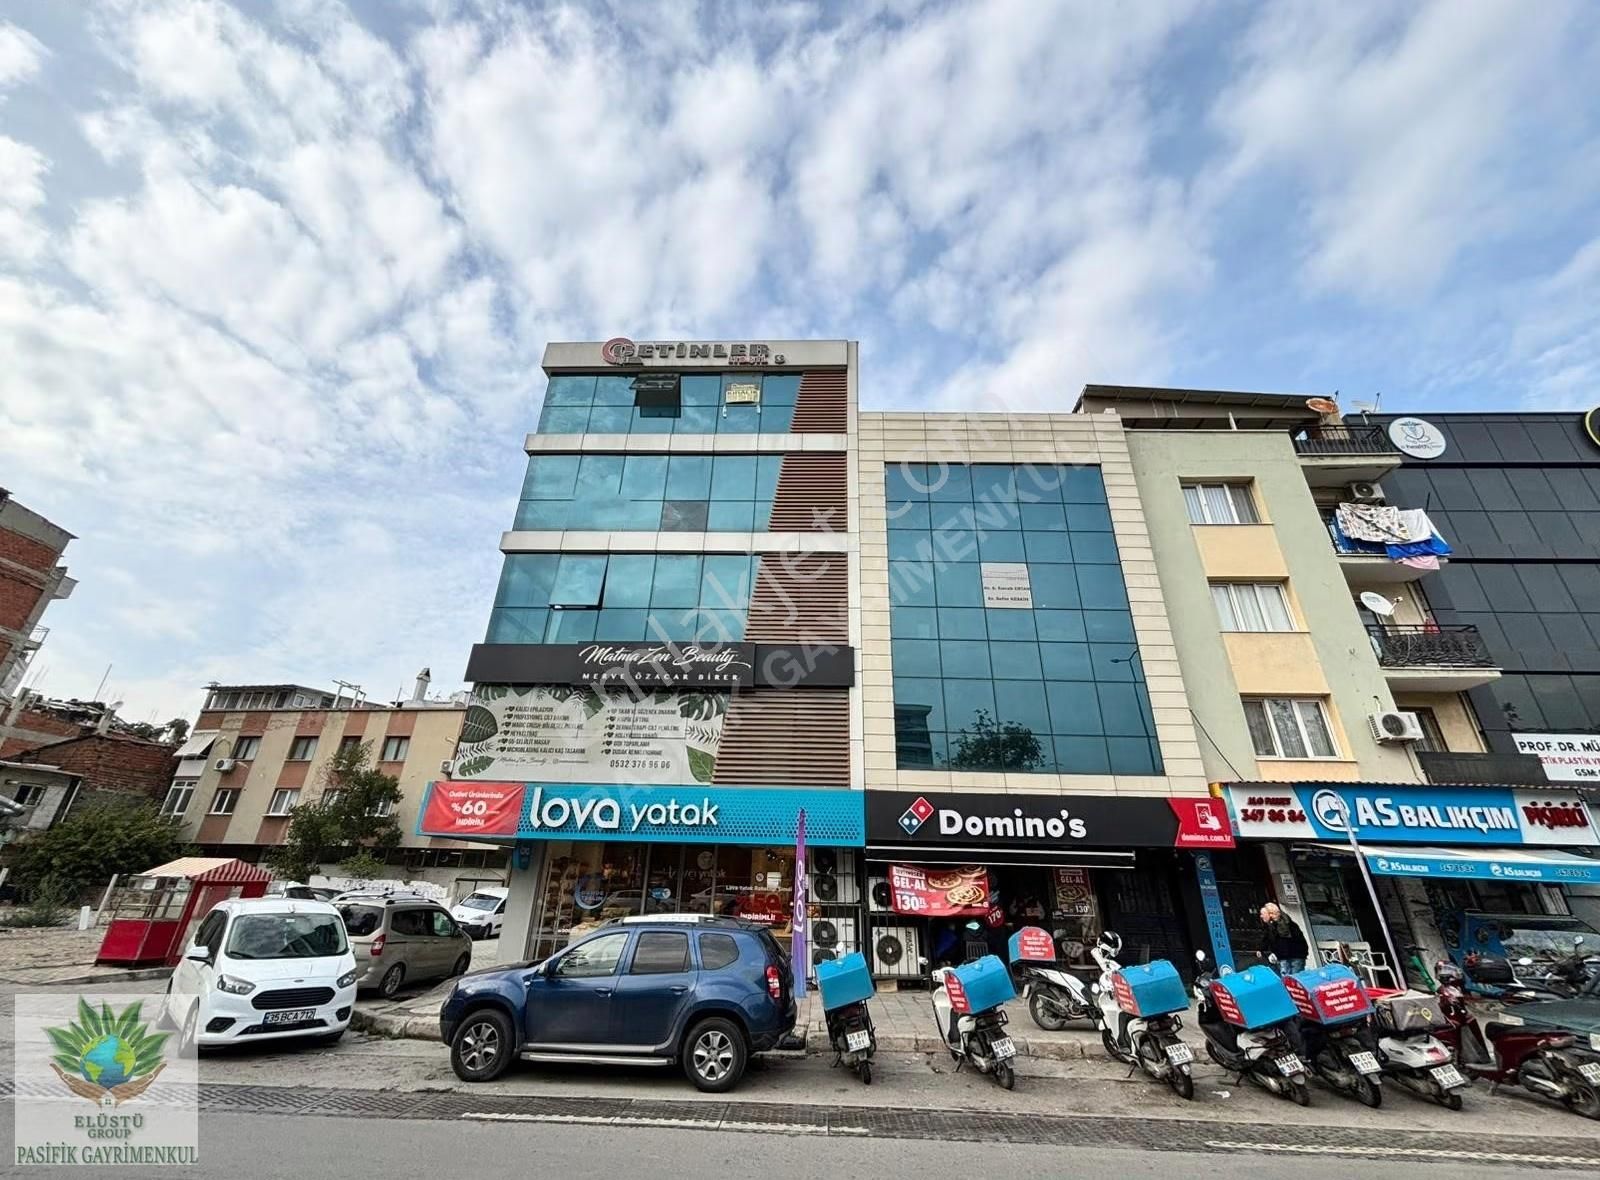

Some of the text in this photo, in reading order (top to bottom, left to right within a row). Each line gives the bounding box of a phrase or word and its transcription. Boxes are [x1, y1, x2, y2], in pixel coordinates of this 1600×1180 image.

[637, 646, 671, 665] Zen
[672, 646, 752, 672] Beauty
[698, 672, 738, 681] BİRER
[1518, 741, 1557, 752] PROF.
[1557, 742, 1580, 752] DR.
[610, 760, 630, 768] 0532
[1560, 756, 1592, 765] PLASTİK
[451, 800, 487, 816] %60
[530, 786, 719, 832] lova yatak
[1356, 797, 1518, 834] AS BALIKÇIM
[938, 808, 1087, 838] Domino's
[1181, 833, 1232, 842] dominos.com.tr
[893, 875, 927, 891] GEL-AL
[1060, 876, 1084, 884] GEL-AL
[271, 1014, 280, 1022] 35
[280, 1012, 299, 1020] BCA
